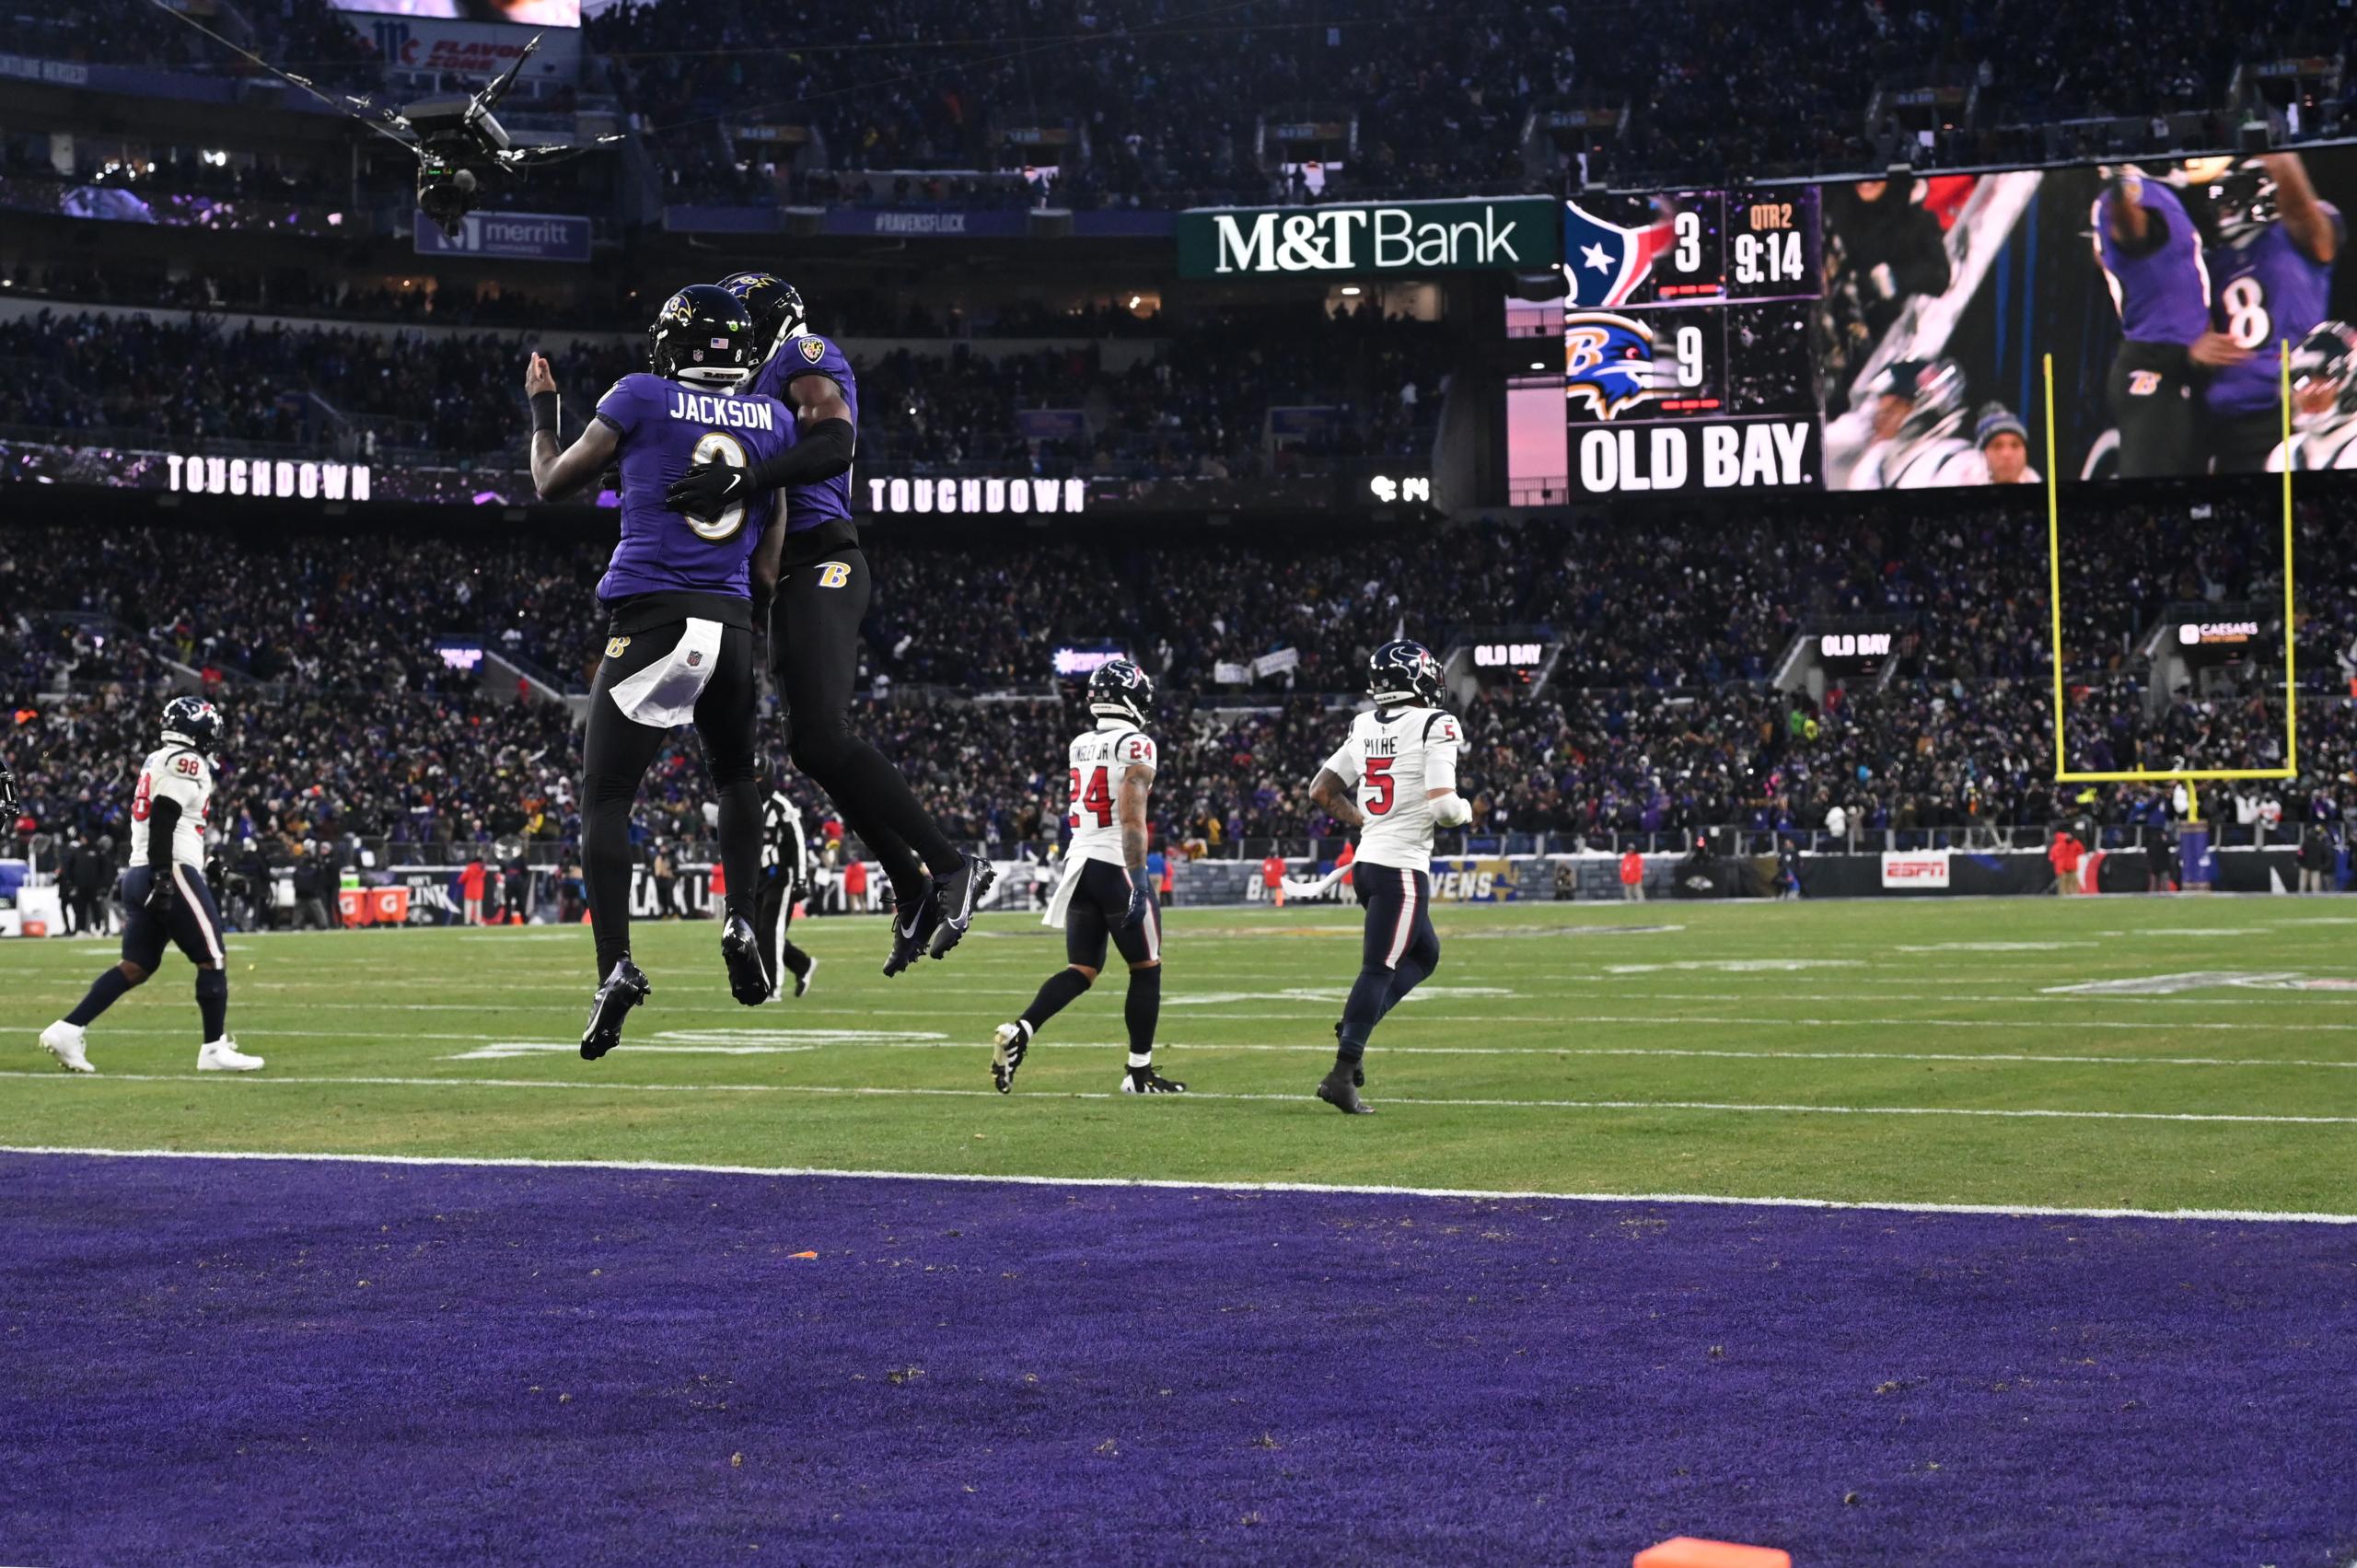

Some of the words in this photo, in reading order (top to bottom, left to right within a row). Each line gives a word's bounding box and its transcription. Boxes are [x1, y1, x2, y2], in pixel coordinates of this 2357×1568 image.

[485, 221, 569, 244] merritt
[876, 213, 965, 231] #RAVENSFLOCK
[1213, 209, 1366, 273] M&T
[1374, 205, 1520, 268] Bank
[1674, 211, 1701, 273] 3
[1735, 231, 1805, 284] 9:14
[2222, 276, 2271, 349] 8
[735, 348, 742, 363] 8
[1677, 326, 1703, 387] 9
[669, 392, 772, 431] JACKSON
[1580, 427, 1688, 493] OLD
[167, 455, 370, 501] TOUCHDOWN
[868, 478, 1084, 513] TOUCHDOWN
[2199, 621, 2258, 636] CAESARS
[1474, 645, 1508, 667] OLD
[1509, 644, 1542, 665] BAY
[1821, 634, 1855, 656] OLD
[1857, 633, 1891, 655] BAY
[1444, 725, 1457, 740] 5
[1130, 740, 1152, 761] 24
[1364, 736, 1399, 756] PITRE
[176, 758, 200, 776] 98
[1363, 756, 1396, 816] 5
[407, 875, 432, 887] DON'T
[1886, 862, 1945, 877] ESPN
[340, 896, 356, 914] G
[379, 894, 399, 913] G
